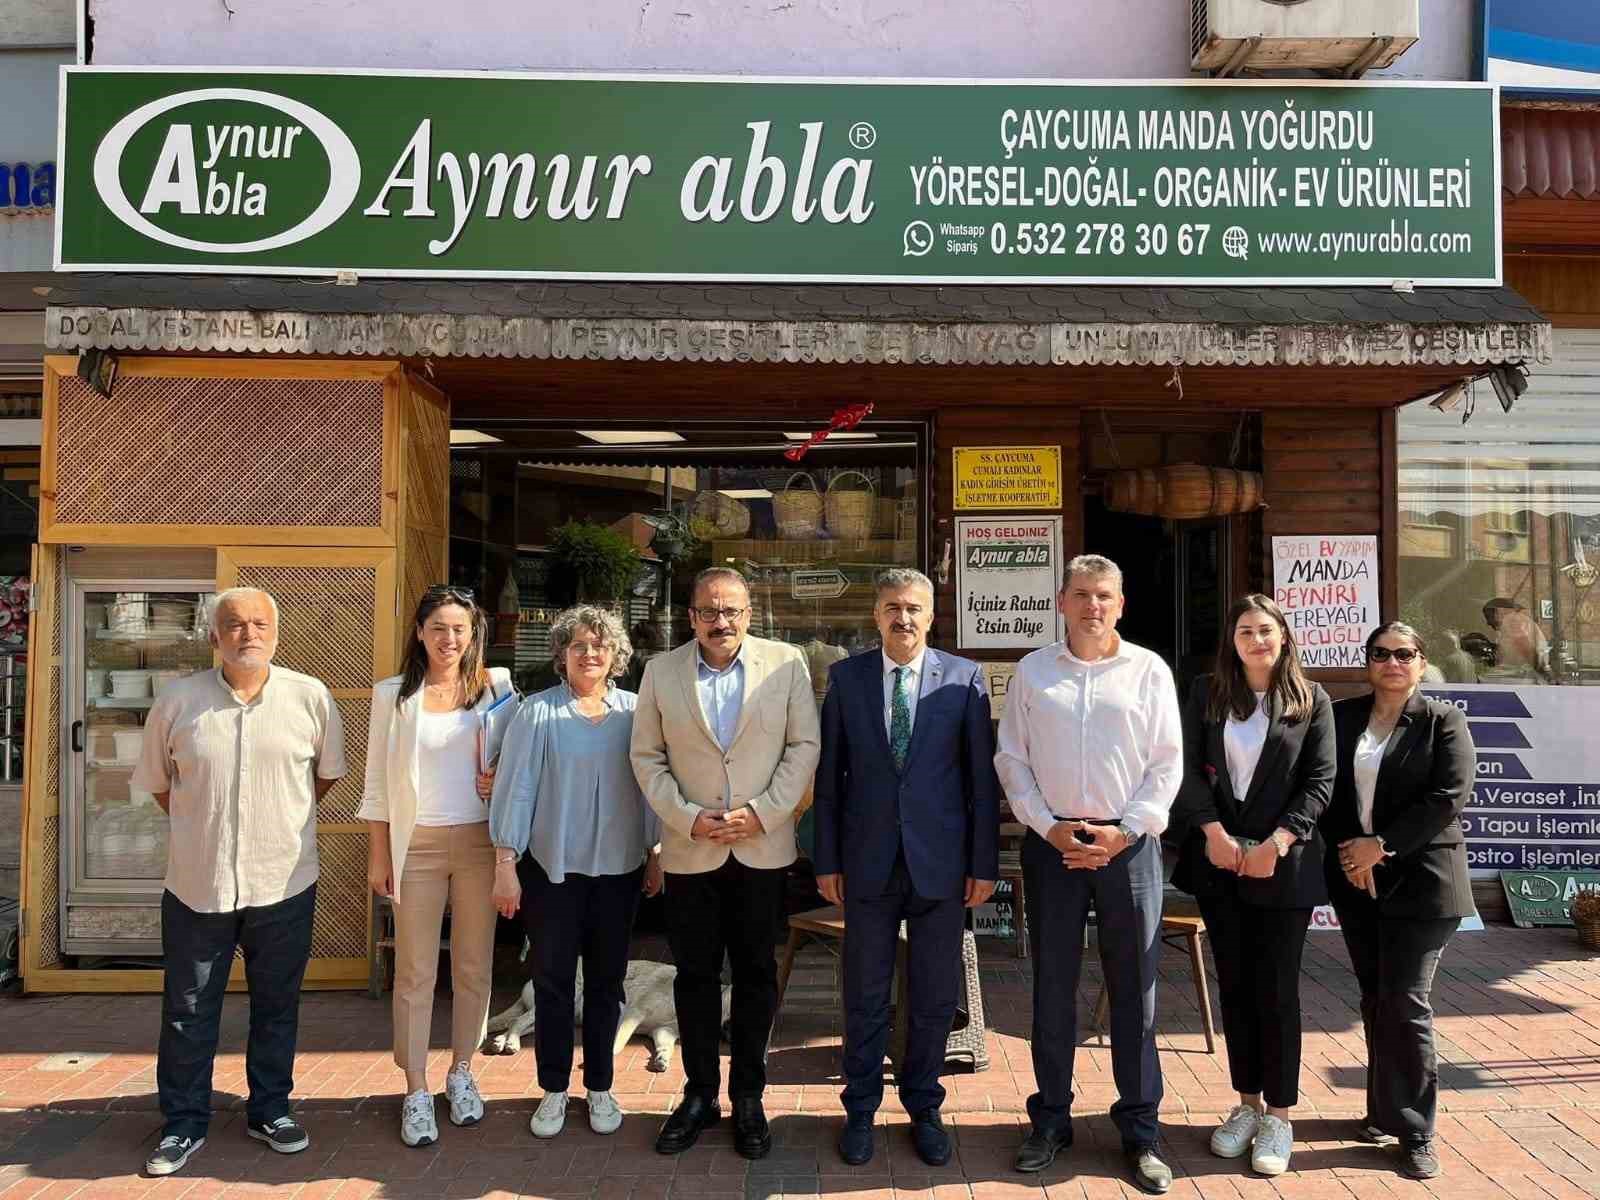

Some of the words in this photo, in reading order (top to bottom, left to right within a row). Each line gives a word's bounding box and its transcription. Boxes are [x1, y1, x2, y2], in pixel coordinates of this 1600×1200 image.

[1000, 108, 1131, 159] ÇAYCUMA
[1138, 110, 1235, 150] MANDA
[1240, 99, 1374, 151] YOĞURDU
[363, 118, 653, 256] Aynur
[680, 120, 875, 224] abla
[1153, 157, 1288, 208] ORGANİK-
[1295, 167, 1330, 208] EV
[1337, 157, 1471, 208] ÜRÜNLERİ
[940, 223, 985, 239] Whatsapp
[990, 222, 1067, 255] 0.532
[1075, 222, 1126, 255] 278
[1135, 222, 1168, 256] 30
[1176, 222, 1211, 256] 67
[1257, 218, 1472, 261] www.aynurabla.com
[946, 239, 978, 256] Sipariş
[260, 317, 311, 340] BALI
[570, 323, 679, 349] PEYNİR
[967, 528, 991, 540] HOŞ
[968, 547, 1014, 567] Aynur
[1015, 546, 1048, 563] abla
[1319, 540, 1337, 557] EV
[1288, 559, 1369, 583] MANDA
[967, 591, 1007, 617] İçiniz
[1010, 595, 1052, 612] Rahat
[1276, 582, 1358, 609] PEYNİRİ
[976, 617, 1010, 634] Etsin
[1013, 617, 1044, 639] Diye
[1476, 760, 1504, 775] an
[1469, 787, 1566, 806] n,Veraset
[1478, 816, 1529, 837] Tapu
[1467, 847, 1515, 865] ostro
